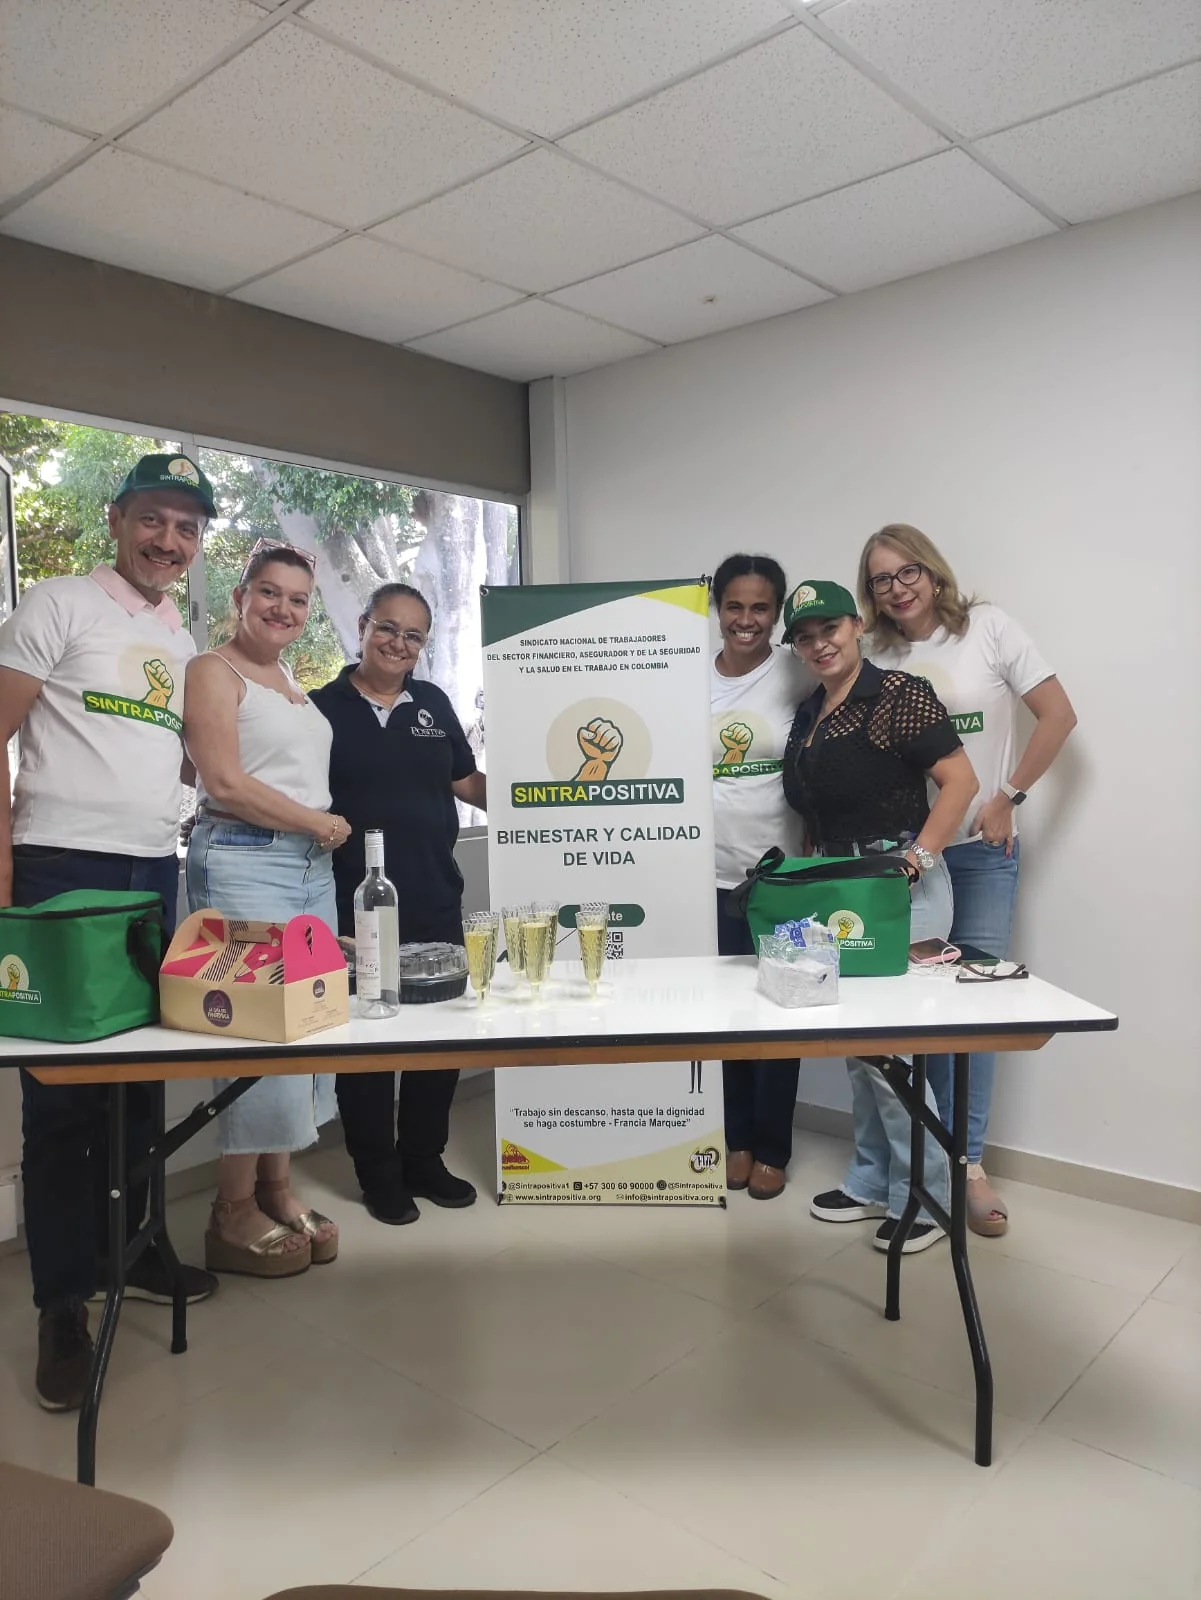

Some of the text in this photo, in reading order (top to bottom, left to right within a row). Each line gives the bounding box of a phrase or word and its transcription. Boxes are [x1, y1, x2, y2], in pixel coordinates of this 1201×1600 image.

[520, 638, 558, 647] SINDICATO
[560, 637, 596, 646] NACIONAL
[609, 634, 666, 644] TRABAJADORES
[487, 653, 500, 661] DEL
[532, 651, 578, 660] FINANCIERO,
[580, 650, 628, 659] ASEGURADOR
[659, 646, 701, 656] SEGURIDAD
[584, 664, 617, 672] TRABAJO
[631, 662, 669, 670] COLOMBIA
[514, 783, 680, 803] SINTRAPOSITIVA
[497, 826, 701, 845] BIENESTAR Y CALIDAD
[563, 851, 636, 866] DE VIDA
[548, 1107, 561, 1116] sin
[564, 1107, 608, 1117] descanso,
[611, 1107, 635, 1116] hasta
[637, 1108, 653, 1117] que
[656, 1107, 664, 1116] la
[666, 1106, 705, 1117] dignidad
[536, 1119, 557, 1129] haga
[559, 1119, 606, 1127] costumbre
[614, 1118, 646, 1127] Francia
[583, 1182, 598, 1190] +57
[601, 1182, 615, 1190] 300
[618, 1182, 627, 1190] 60
[629, 1182, 654, 1190] 90000
[515, 1193, 714, 1202] www.sintrapositiva.org info@sintrapositiva.org
